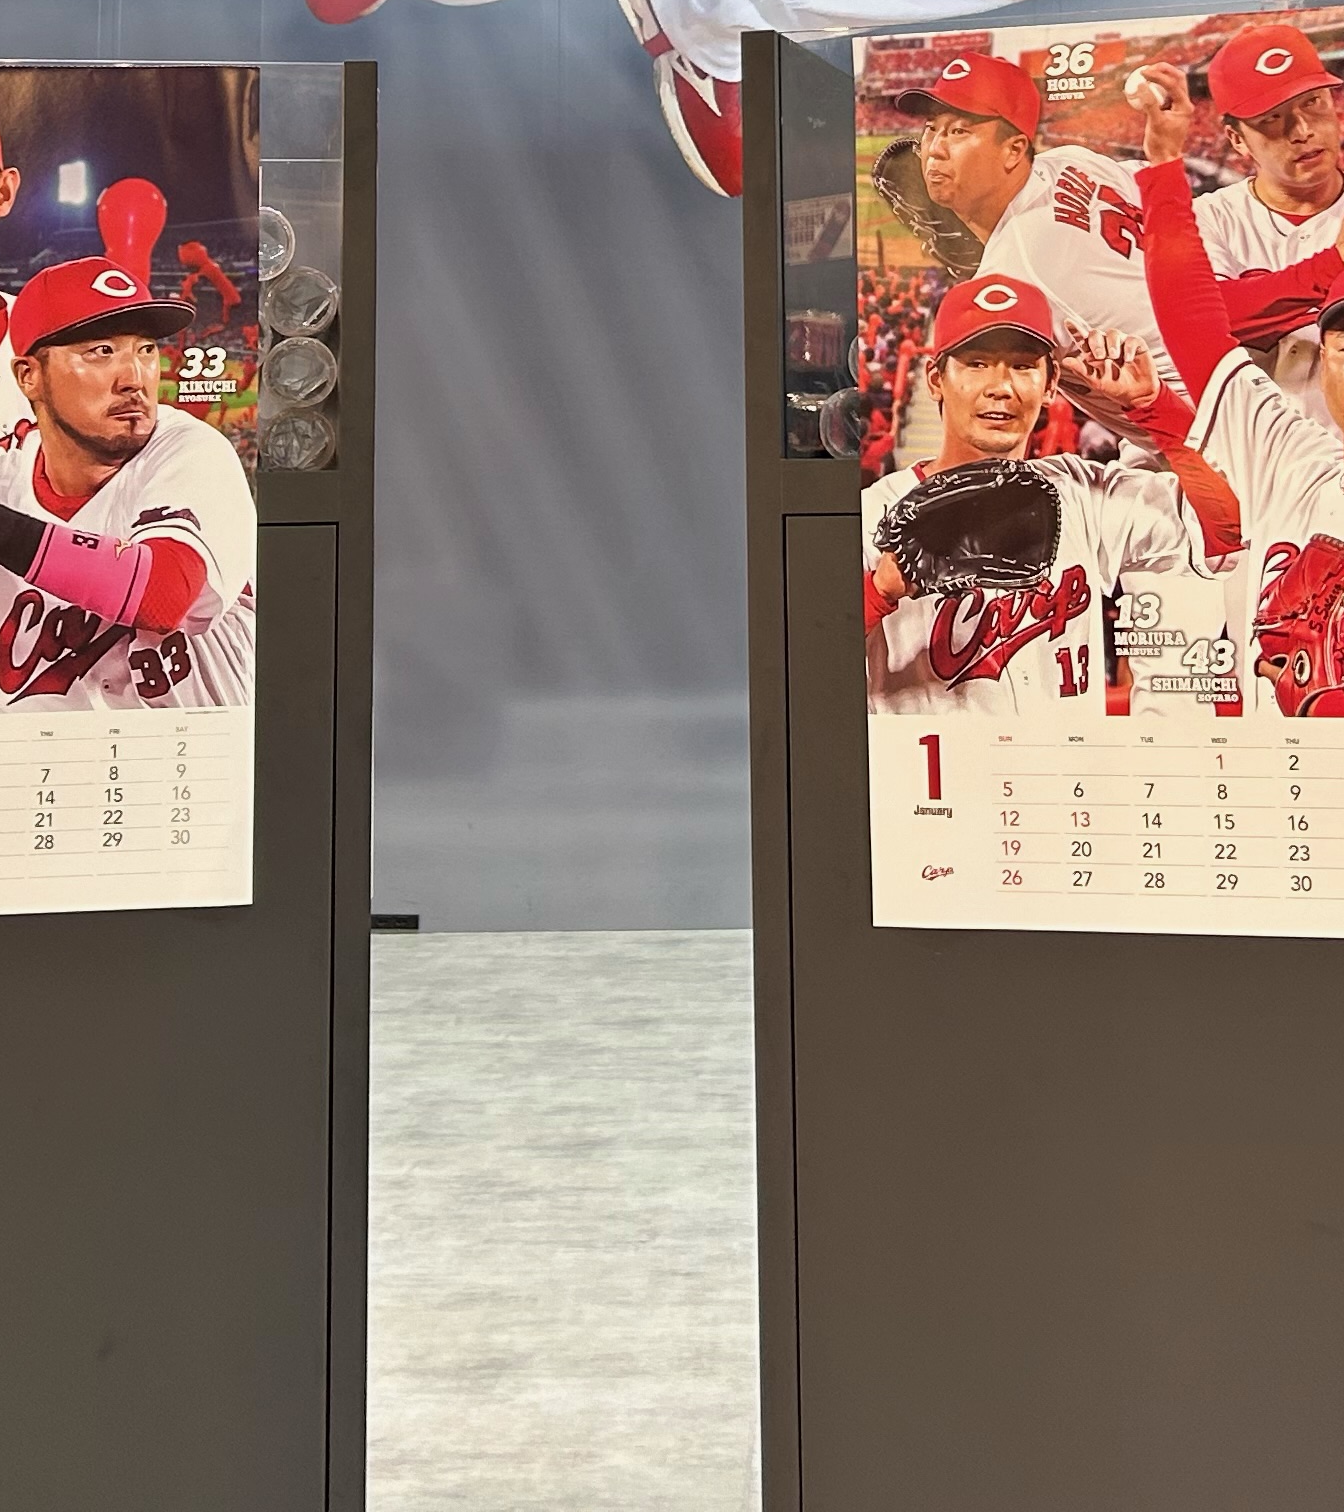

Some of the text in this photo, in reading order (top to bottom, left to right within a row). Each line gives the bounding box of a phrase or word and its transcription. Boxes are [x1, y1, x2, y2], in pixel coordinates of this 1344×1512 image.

[1045, 43, 1096, 77] 36
[1046, 76, 1096, 93] HORIE
[1054, 165, 1099, 233] HORIE
[178, 347, 227, 379] 33
[178, 380, 237, 393] KIKUCHI
[1114, 593, 1160, 629] 13
[1113, 631, 1186, 646] MORIURA
[128, 631, 192, 699] 33
[1182, 639, 1236, 675] 43
[1152, 677, 1239, 692] SHIMAUCHI
[919, 734, 942, 800] 1
[36, 791, 56, 805] 14
[104, 788, 123, 803] 15
[172, 786, 191, 800] 16
[914, 804, 952, 818] January
[1000, 810, 1020, 826] 12
[1071, 811, 1091, 827] 13
[1142, 813, 1163, 829] 14
[1213, 814, 1235, 830] 15
[1288, 815, 1309, 831] 16
[34, 835, 55, 850] 28
[103, 832, 123, 847] 29
[171, 830, 190, 844] 30
[1002, 869, 1023, 885] 26
[1072, 871, 1092, 887] 27
[1144, 872, 1165, 888] 28
[1216, 874, 1238, 890] 29
[1290, 875, 1312, 892] 30
